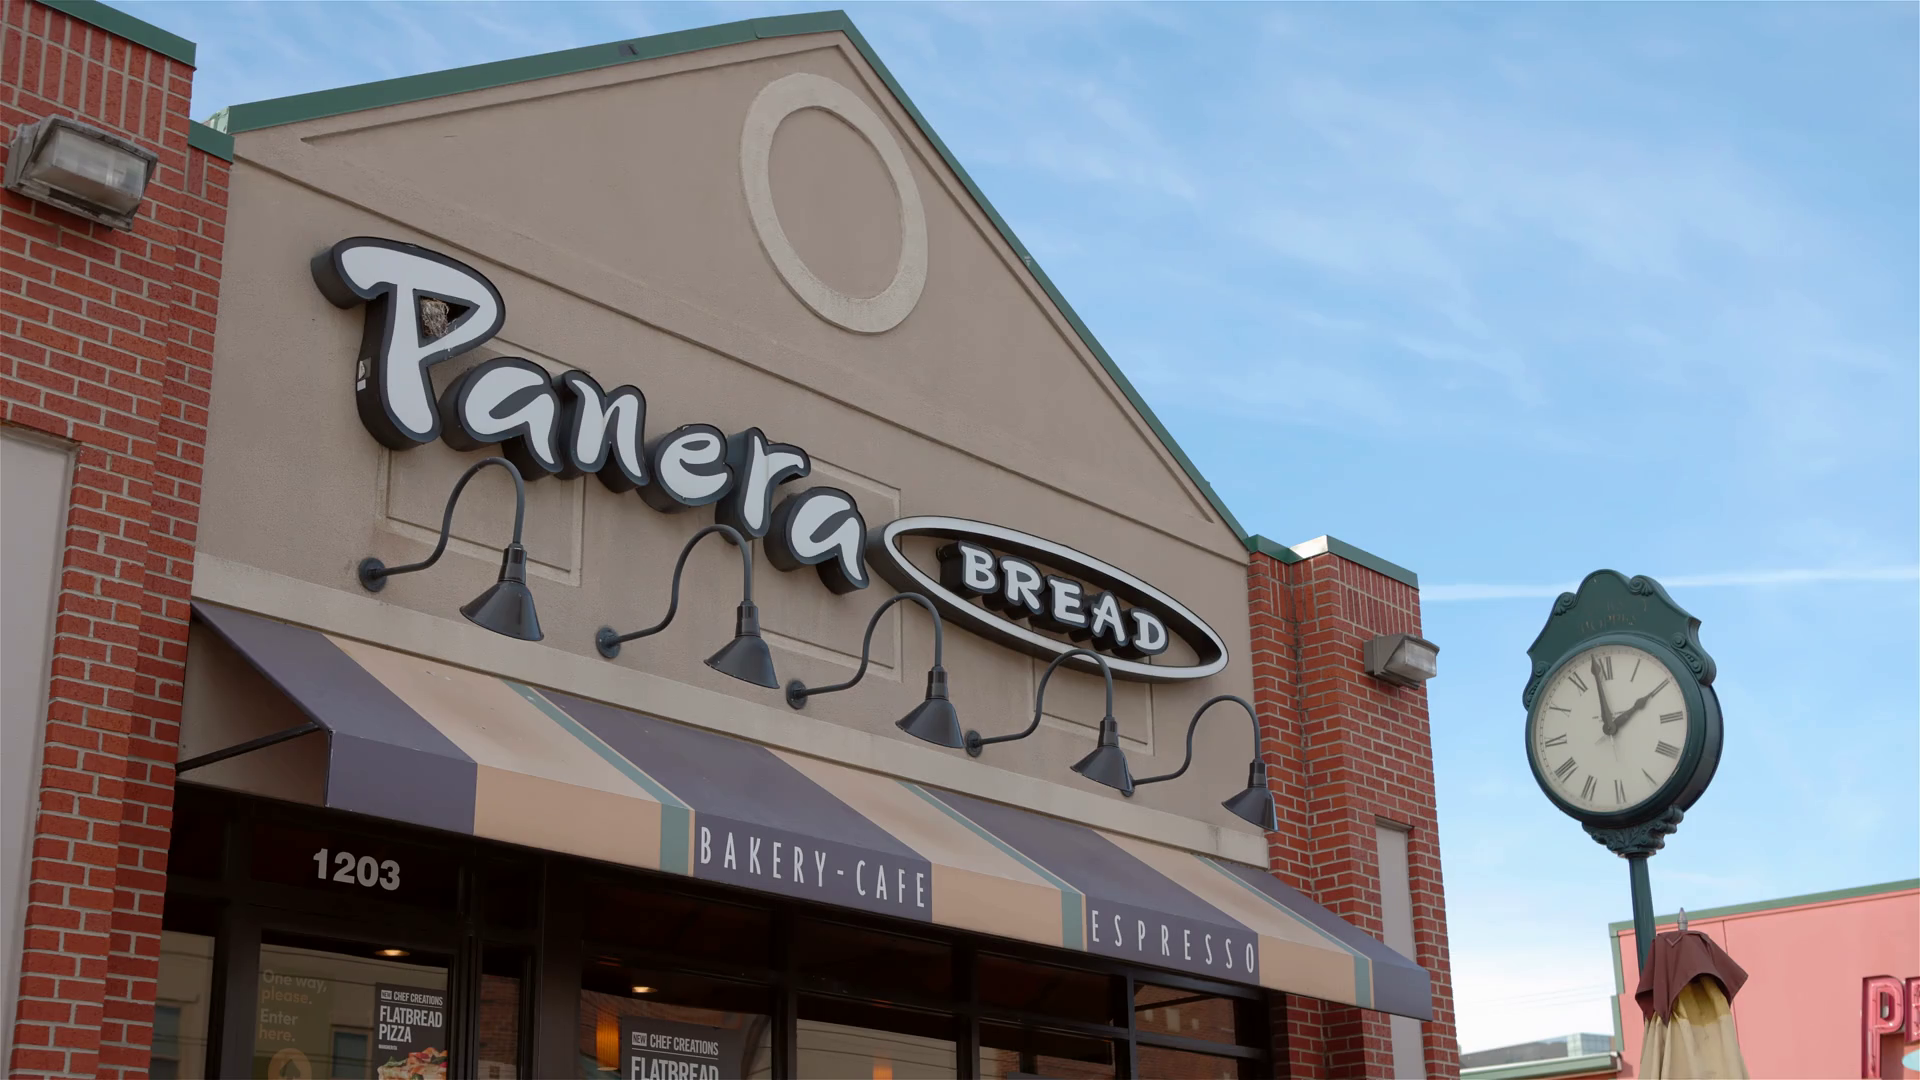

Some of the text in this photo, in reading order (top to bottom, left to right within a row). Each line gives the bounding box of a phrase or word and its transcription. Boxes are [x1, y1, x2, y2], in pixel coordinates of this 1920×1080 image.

[334, 237, 869, 590] Panera
[959, 543, 1167, 653] BREAD
[313, 848, 401, 891] 1203
[699, 826, 926, 909] BAKERY-CAFE
[1091, 909, 1256, 974] ESPRESSO
[263, 969, 327, 994] One way,
[261, 986, 313, 1004] please.
[393, 991, 410, 1002] CHEF
[410, 993, 443, 1006] CREATIONS
[260, 1008, 298, 1026] Enter
[380, 1005, 443, 1028] FLATBREAD
[259, 1024, 296, 1042] here.
[379, 1024, 412, 1044] PIZZA
[650, 1034, 672, 1050] CHEF
[673, 1037, 719, 1056] CREATIONS
[631, 1056, 719, 1080] FLATBREAD
